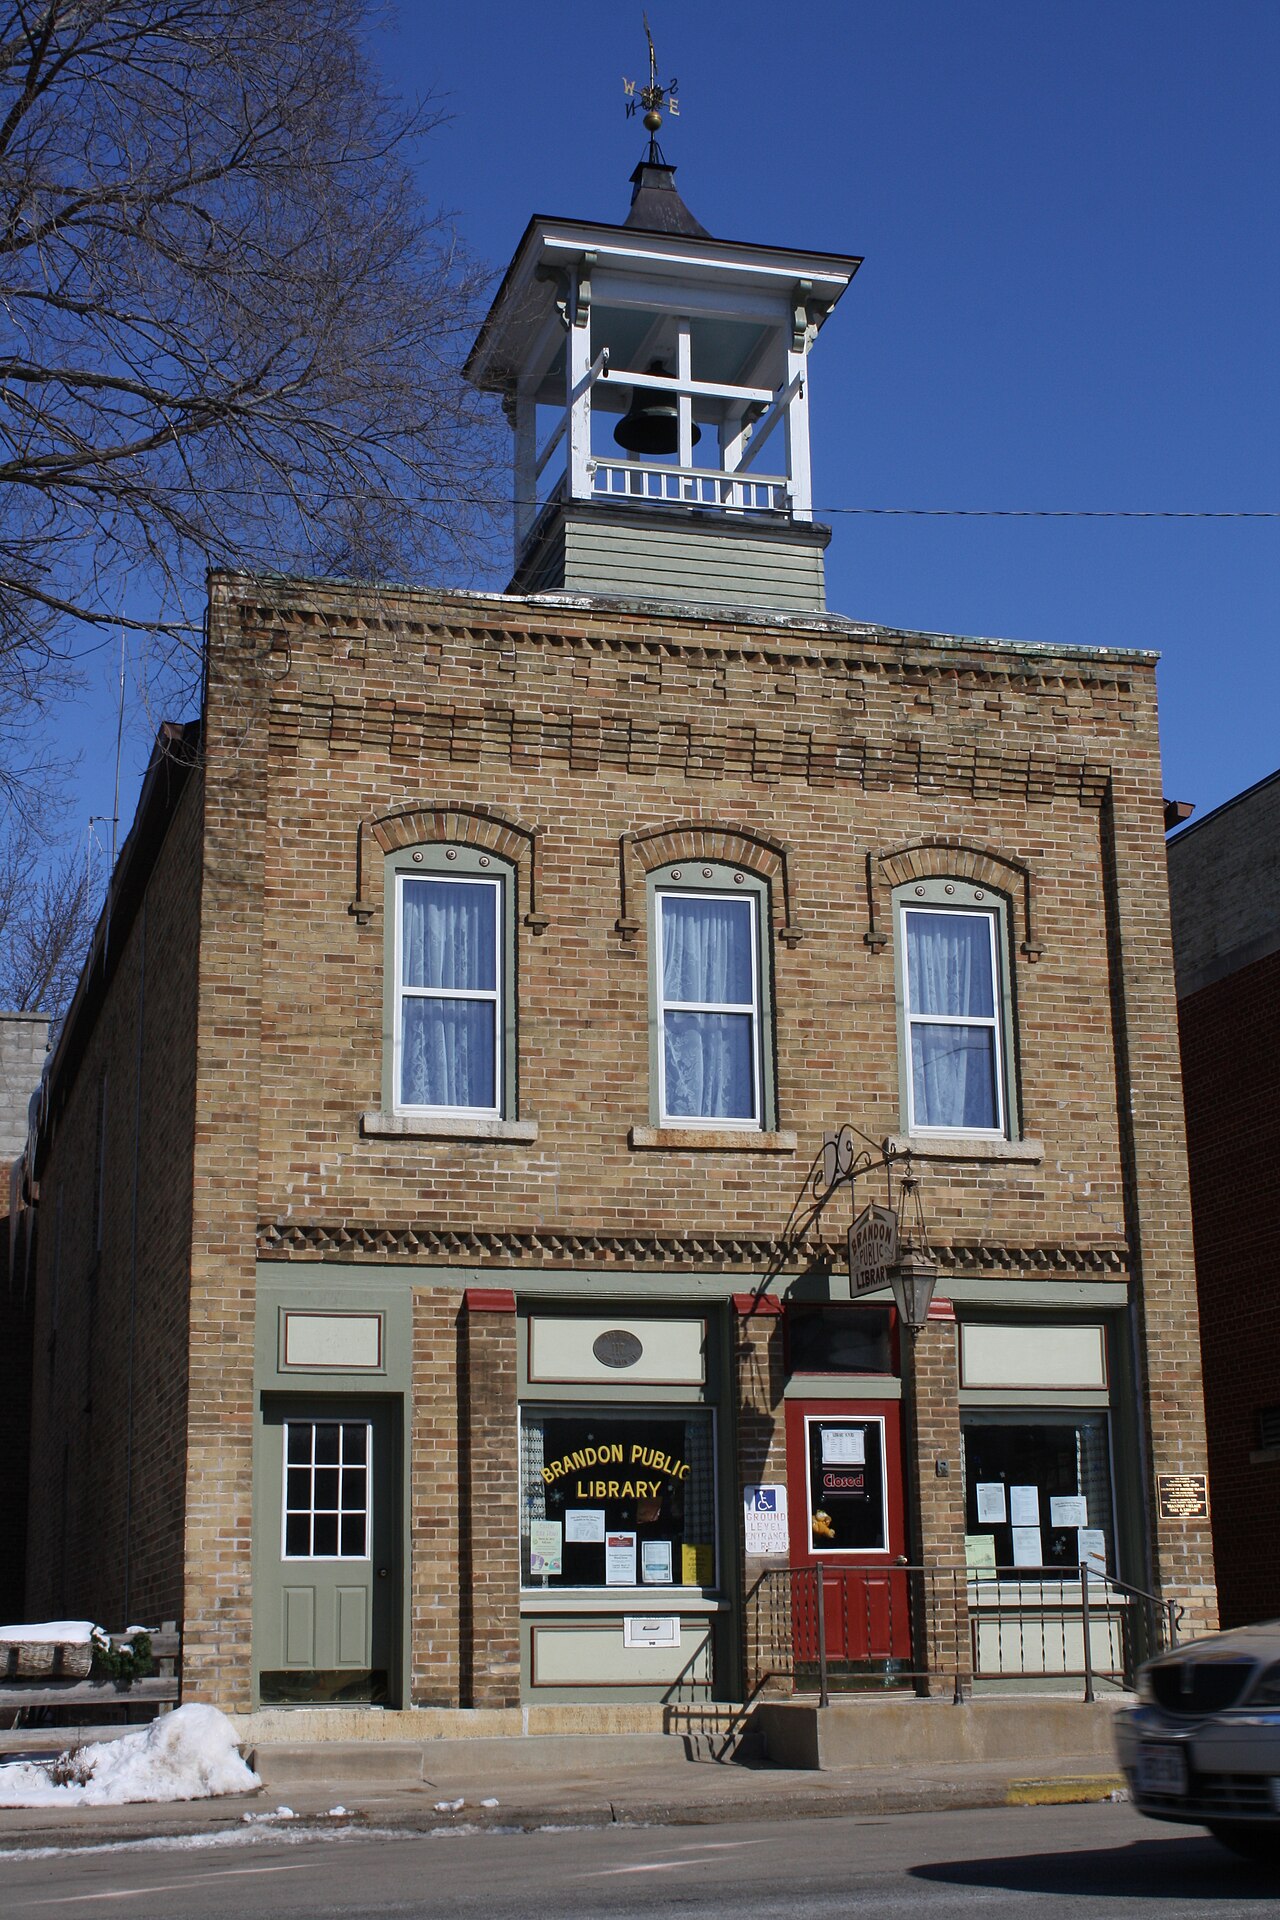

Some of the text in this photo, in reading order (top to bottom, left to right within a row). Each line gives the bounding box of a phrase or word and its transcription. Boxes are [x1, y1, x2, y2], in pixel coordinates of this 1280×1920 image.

[622, 77, 636, 96] W
[669, 98, 680, 116] E
[851, 1223, 892, 1257] BRANDON
[860, 1242, 884, 1266] PUBLIC
[540, 1444, 692, 1484] BRANDON PUBLIC
[577, 1480, 662, 1498] LIBRARY
[823, 1473, 864, 1487] Closed
[746, 1513, 786, 1521] GROUND
[750, 1522, 783, 1531] LEVEL
[761, 1541, 787, 1550] REAR
